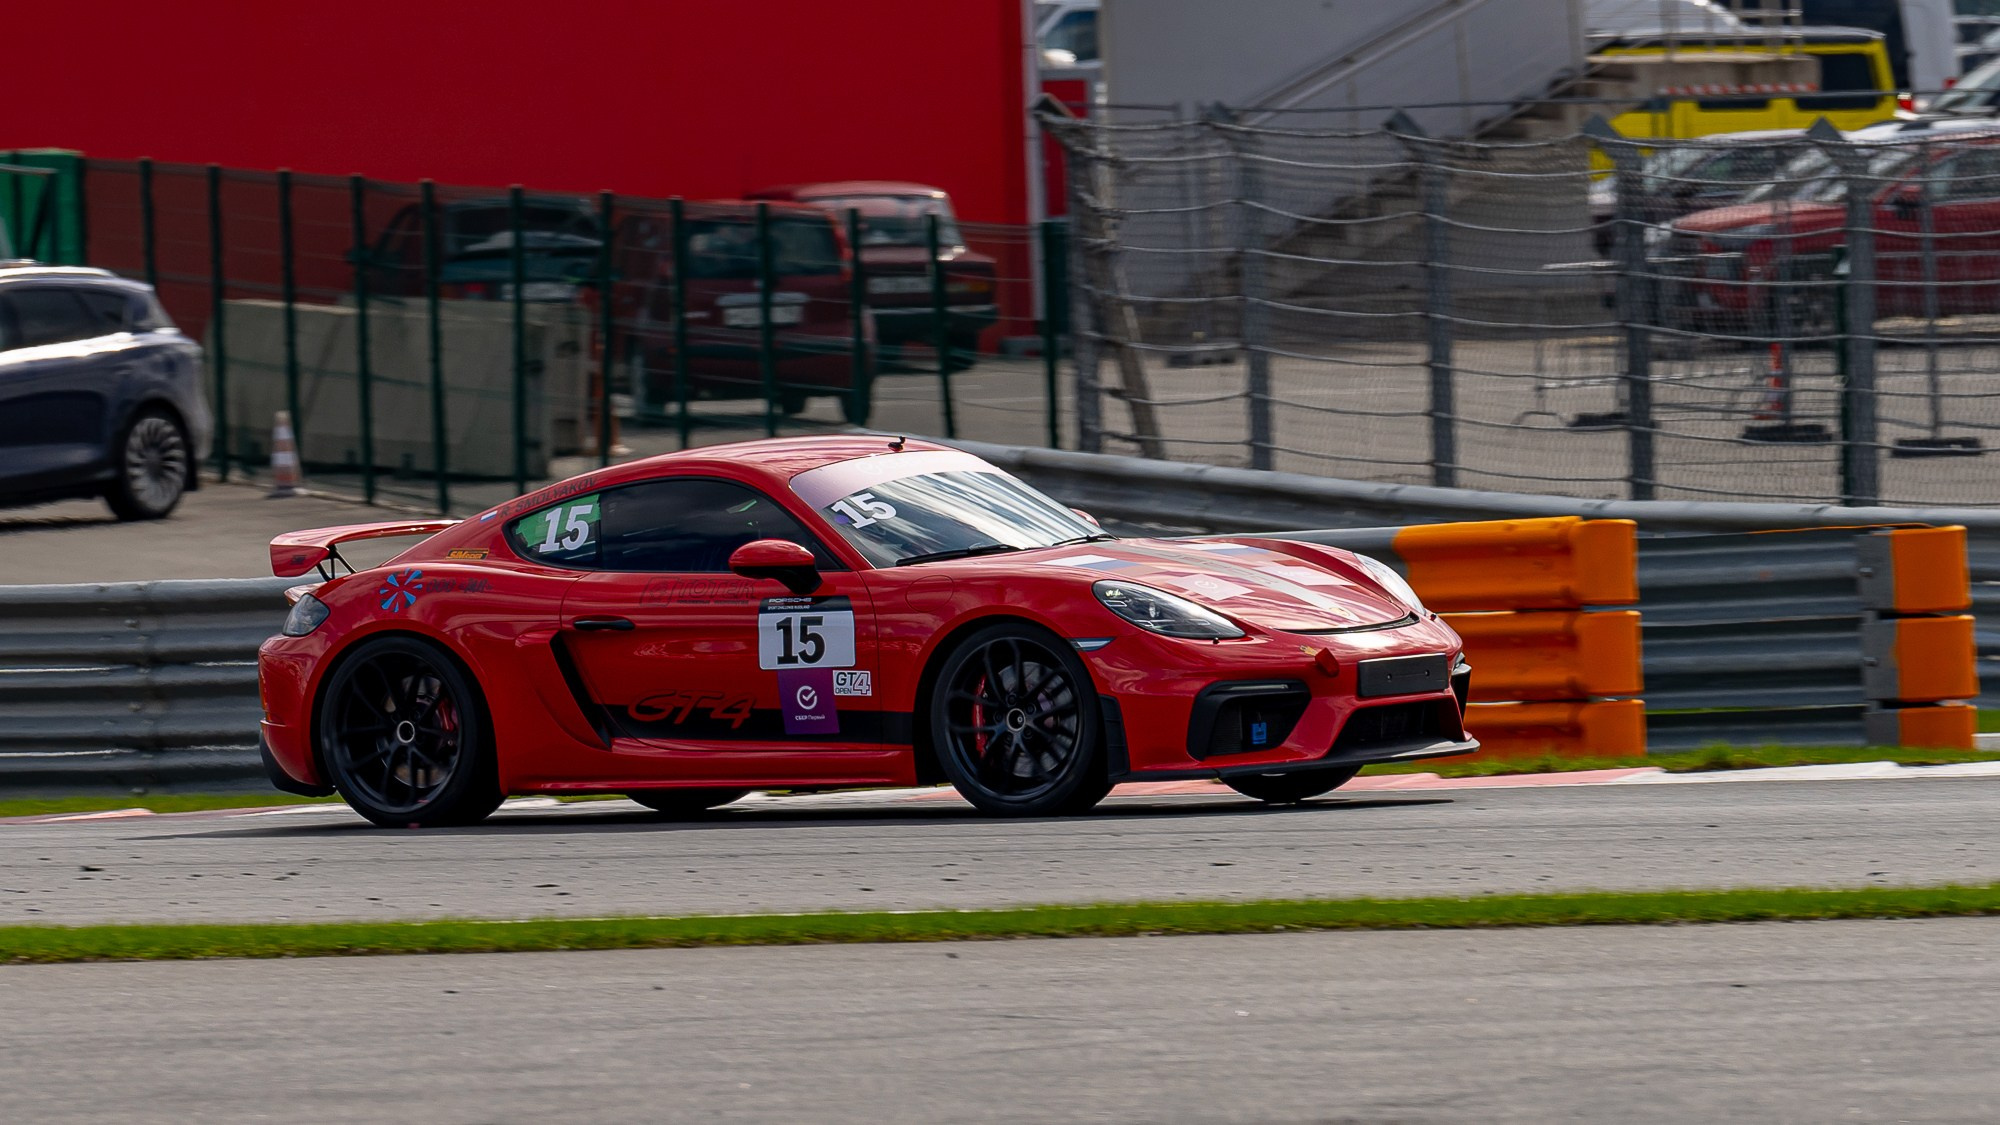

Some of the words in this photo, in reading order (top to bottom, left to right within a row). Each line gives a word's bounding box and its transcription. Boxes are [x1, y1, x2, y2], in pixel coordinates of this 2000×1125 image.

[515, 478, 597, 512] SMOLYAKOV
[831, 493, 897, 529] 15
[539, 504, 593, 552] 15
[776, 616, 825, 664] 15
[836, 672, 870, 695] GT4
[627, 689, 756, 729] GT4
